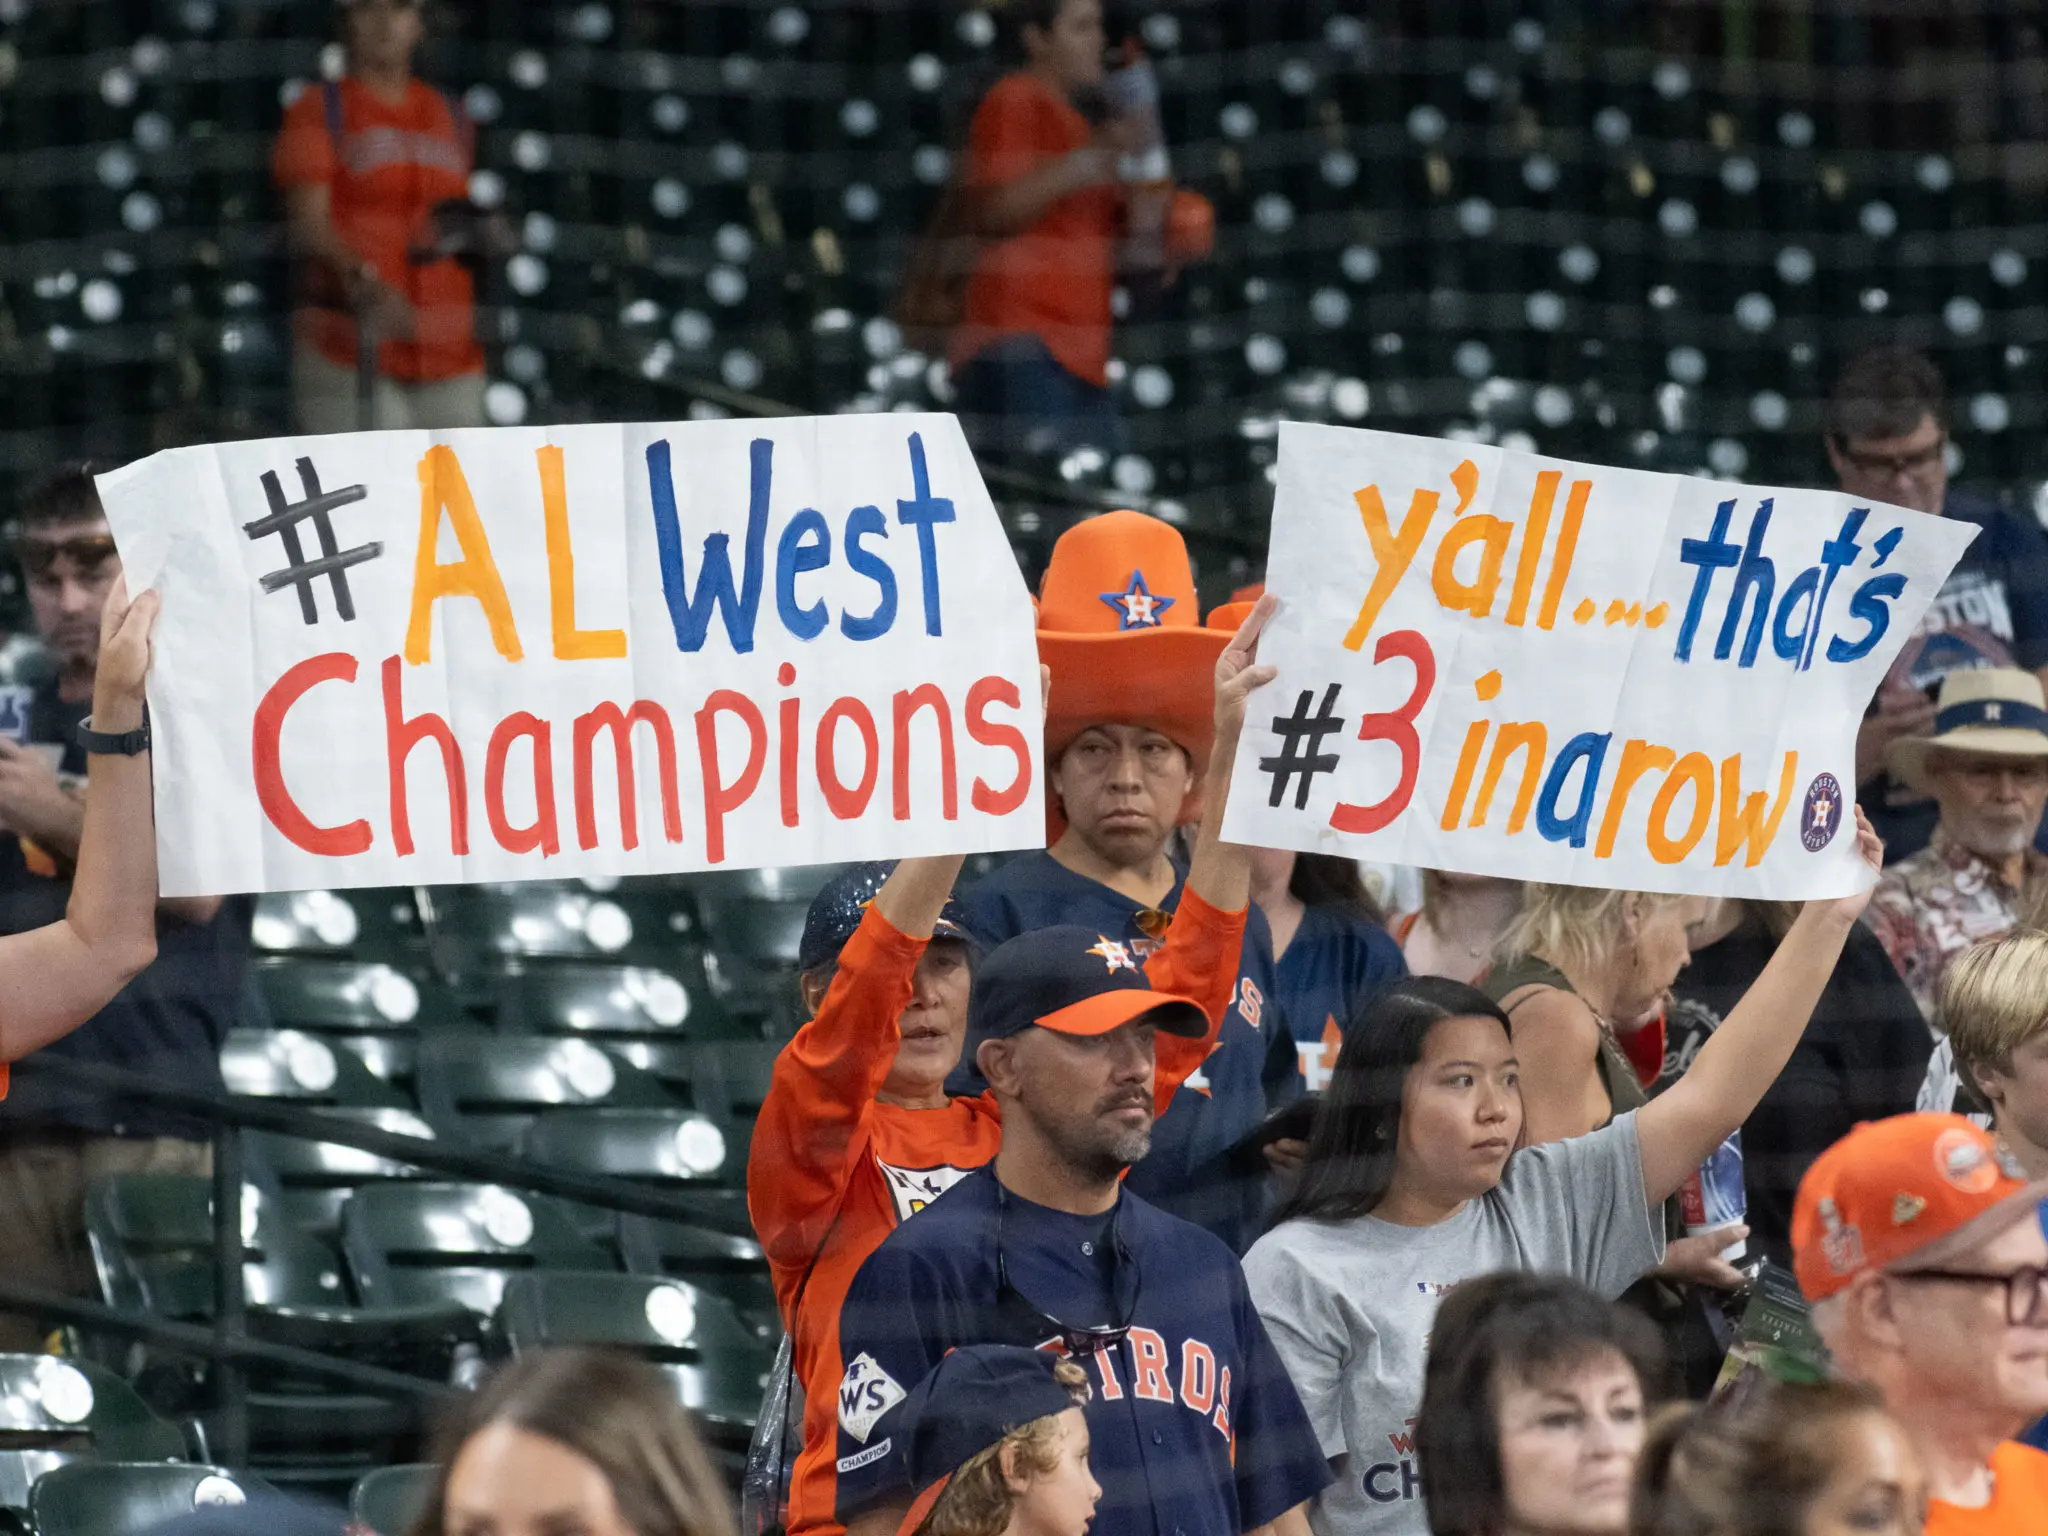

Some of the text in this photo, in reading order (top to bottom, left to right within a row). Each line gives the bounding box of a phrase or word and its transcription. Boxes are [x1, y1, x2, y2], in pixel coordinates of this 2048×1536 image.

[252, 652, 1032, 863] Champions
[1809, 776, 1839, 799] HOUSTON
[839, 1378, 886, 1418] WS
